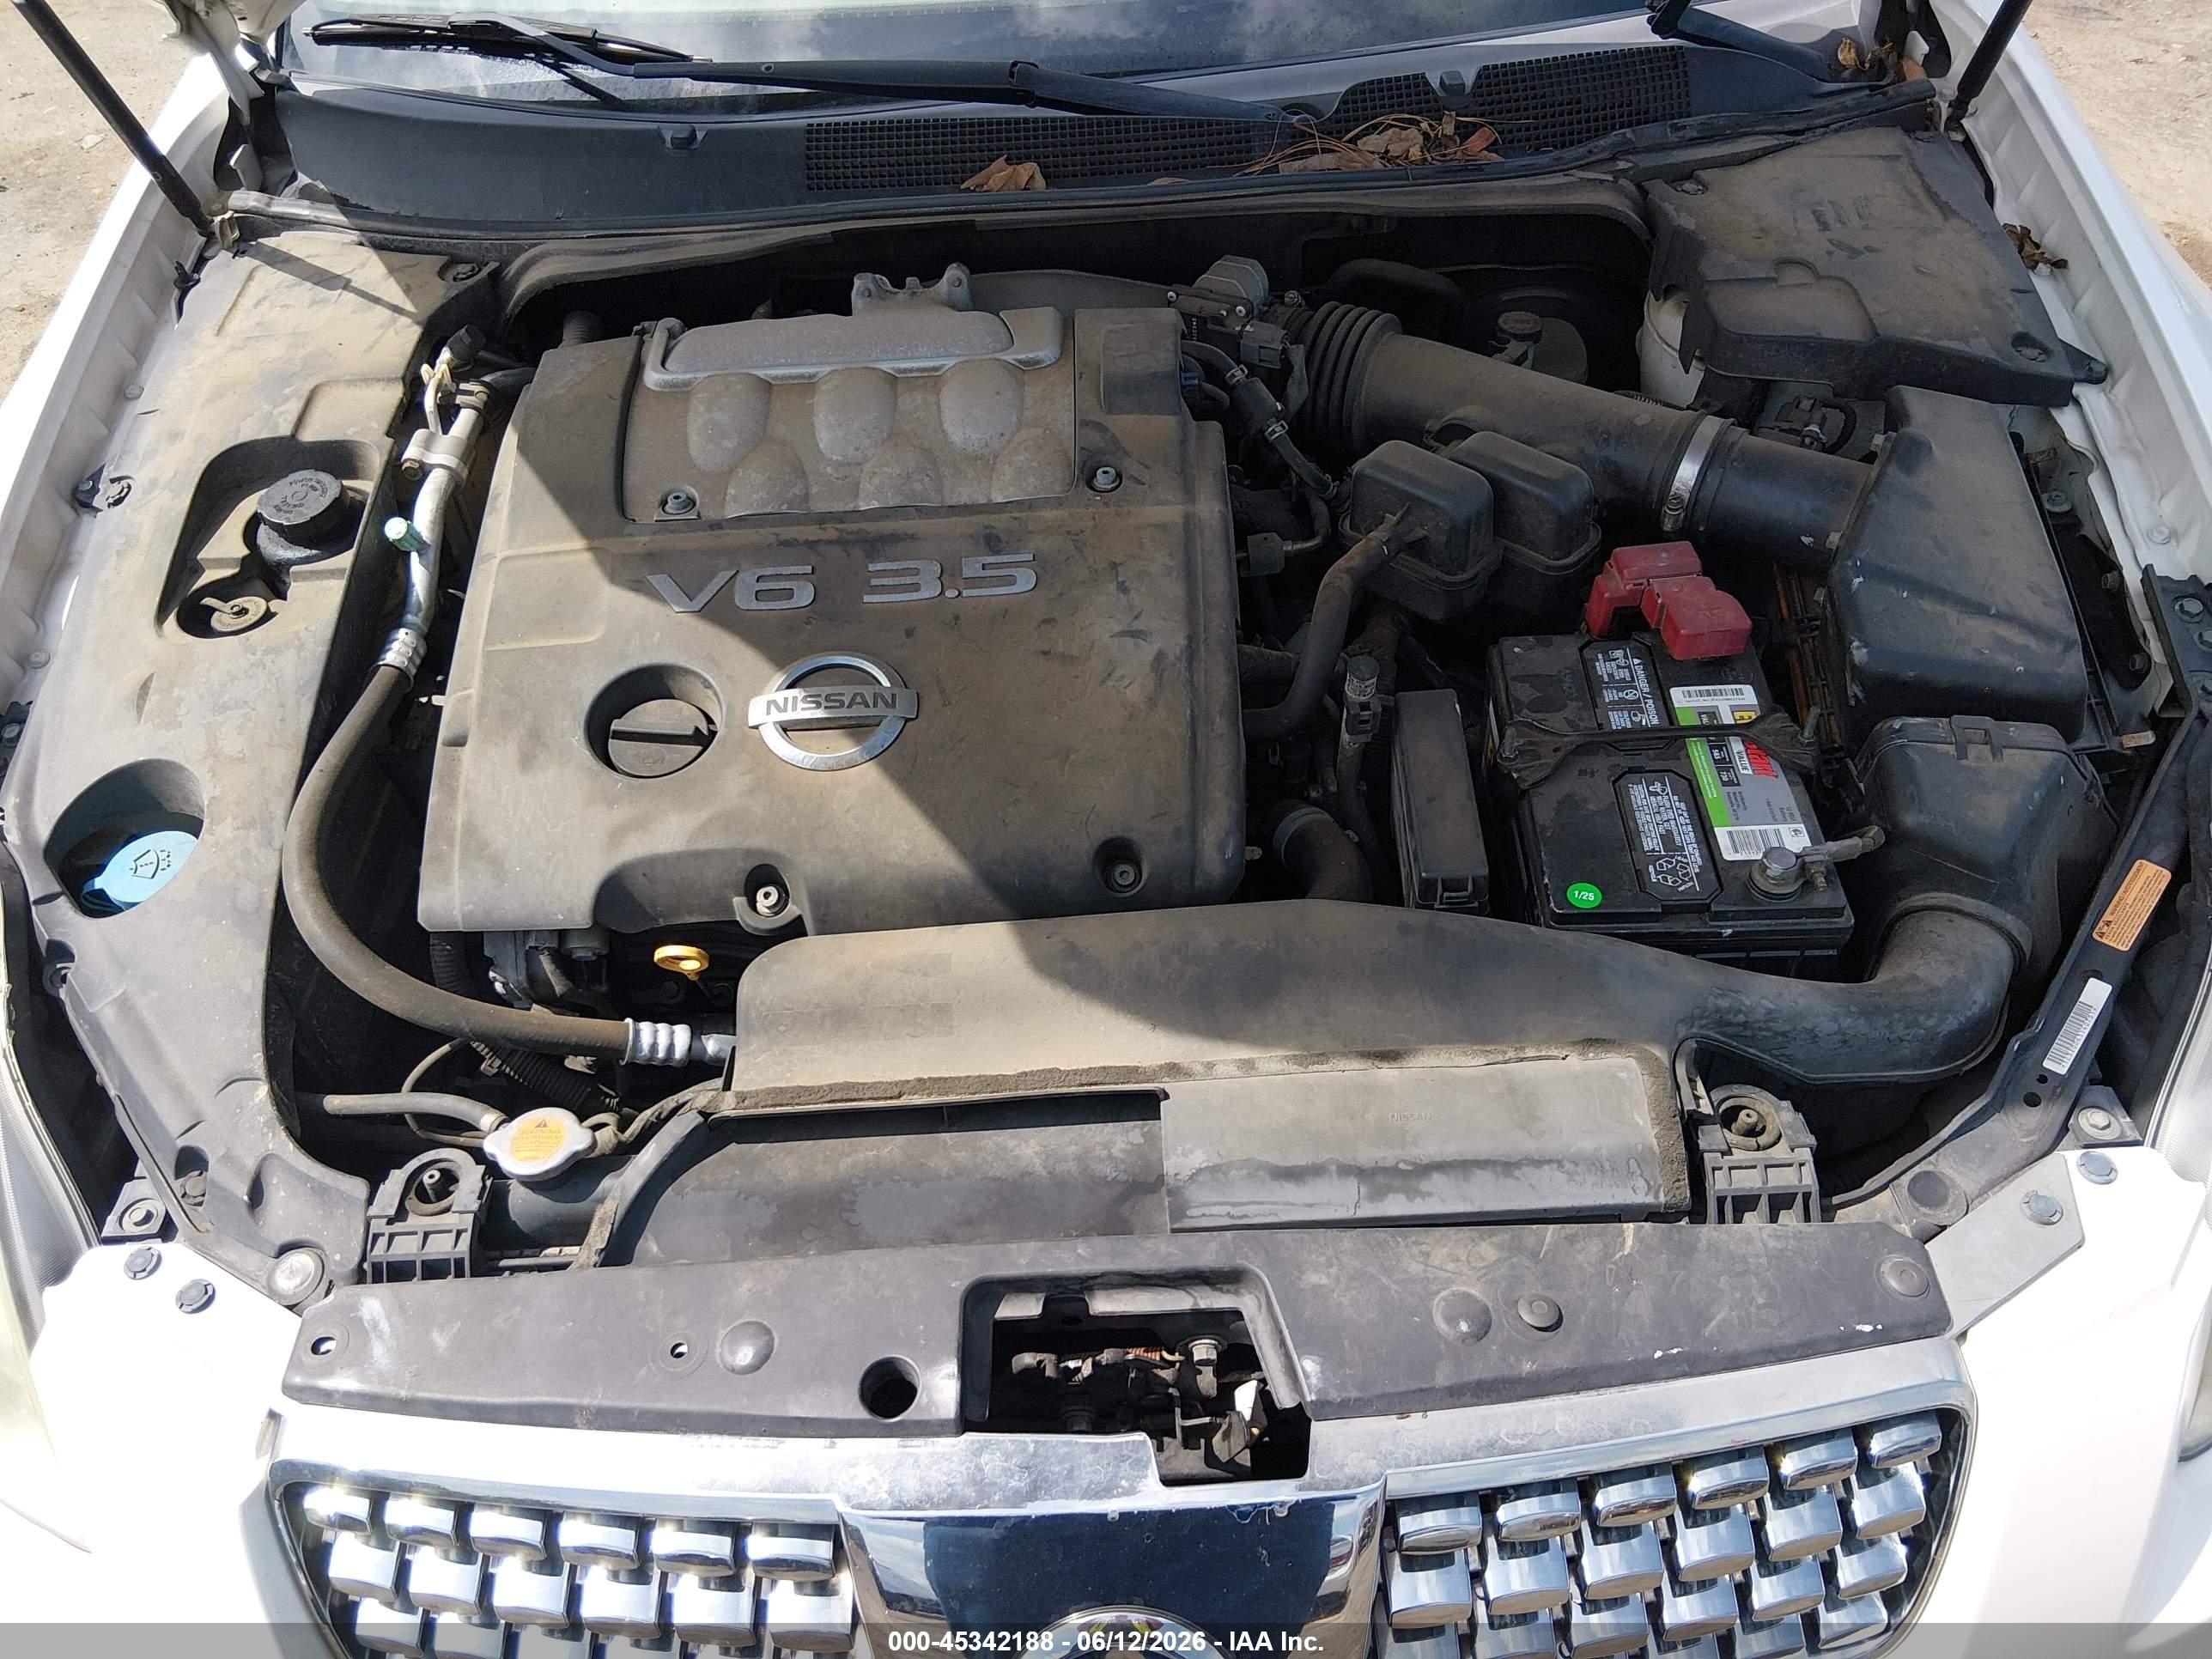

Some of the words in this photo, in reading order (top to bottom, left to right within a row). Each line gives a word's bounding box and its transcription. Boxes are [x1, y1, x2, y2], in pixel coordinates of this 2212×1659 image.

[646, 565, 816, 613] V6
[864, 553, 1038, 605] 3.5
[767, 691, 897, 716] NISSAN
[1635, 665, 1650, 692] DANGER
[1644, 699, 1659, 724] POISON
[1735, 750, 1750, 771] VALUE
[1573, 890, 1595, 902] 1/25
[1390, 1112, 1433, 1122] NISSAN
